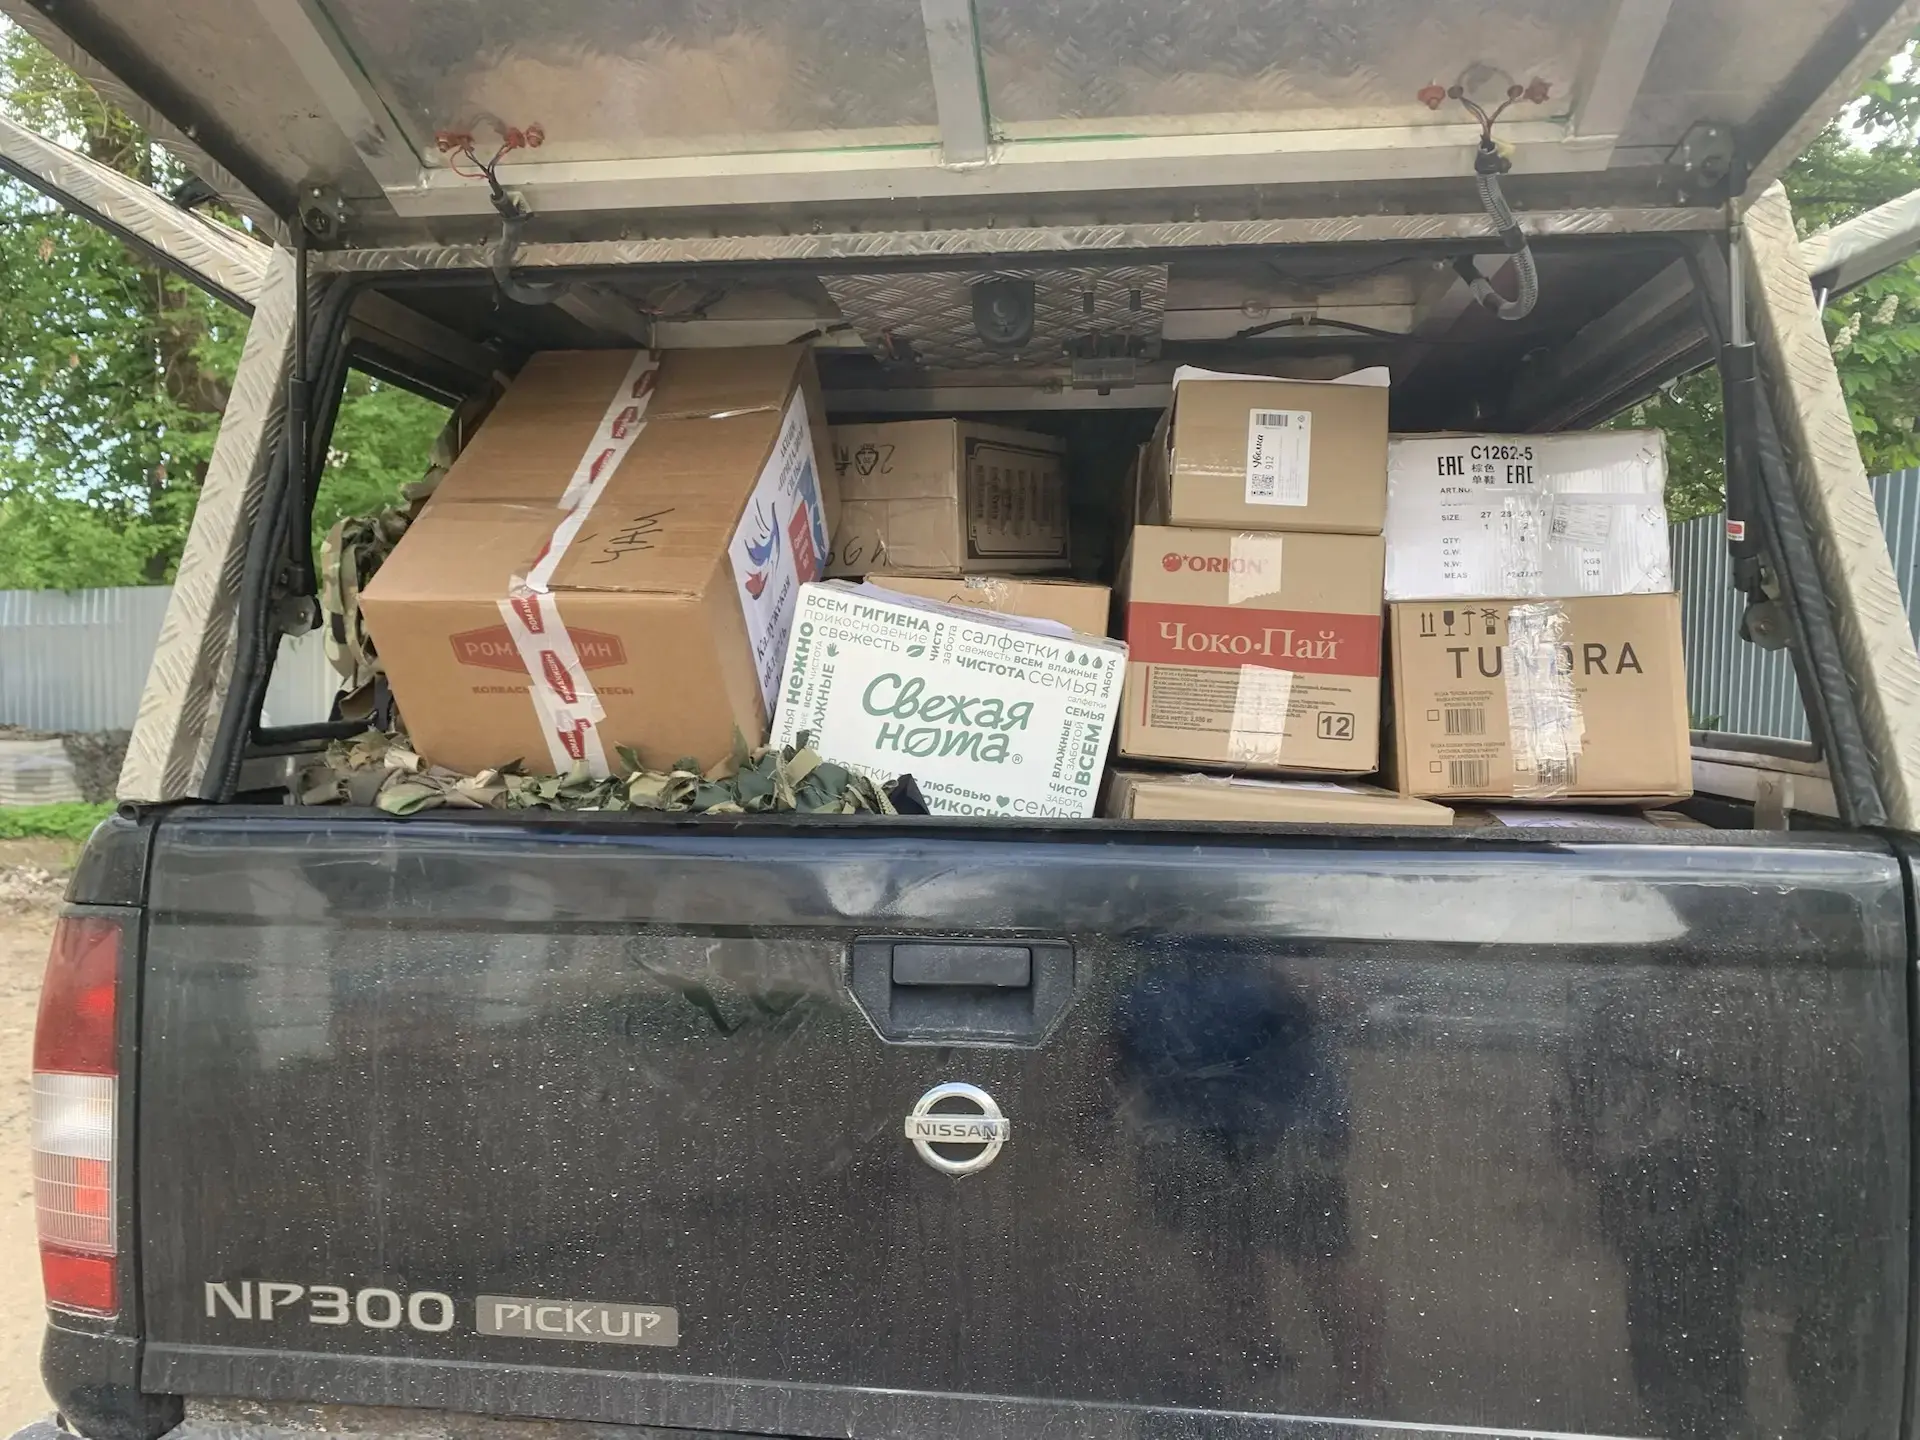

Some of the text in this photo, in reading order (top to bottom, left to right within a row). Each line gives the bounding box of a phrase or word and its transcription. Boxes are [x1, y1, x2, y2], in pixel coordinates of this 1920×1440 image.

[1265, 455, 1274, 470] 912
[1470, 445, 1533, 461] C1262-5
[1480, 511, 1492, 519] 27
[1188, 555, 1264, 575] ORION
[804, 609, 927, 644] прикосновение
[806, 594, 930, 632] ВСЕМ ГИГИЕНА
[818, 625, 900, 652] свежесть
[943, 625, 957, 664] забота
[961, 628, 1060, 661] салфетки
[786, 622, 814, 705] нежно
[809, 640, 823, 680] ЧИСТОТА
[955, 655, 1097, 696] ЧИСТОТА семья
[958, 644, 1098, 680] свежесть ВСЕМ ВЛАЖНЫЕ
[1446, 641, 1643, 679] TUDRA
[1100, 659, 1116, 699] ЗАБОТА
[807, 663, 835, 750] ВЛАЖНЫЕ
[862, 672, 1034, 731] Свежая
[1065, 706, 1105, 722] СЕМЬЯ
[1067, 695, 1107, 709] салфетки
[1321, 715, 1351, 737] 12
[1052, 719, 1072, 778] ВЛАЖНЫЕ
[1066, 721, 1084, 770] ЗАБОТОЙ
[1074, 723, 1102, 786] ВСЕМ
[922, 780, 991, 802] любовью
[1045, 794, 1083, 809] ЗАБОТА
[916, 1122, 998, 1137] NISSAN
[204, 1280, 456, 1333] NP300
